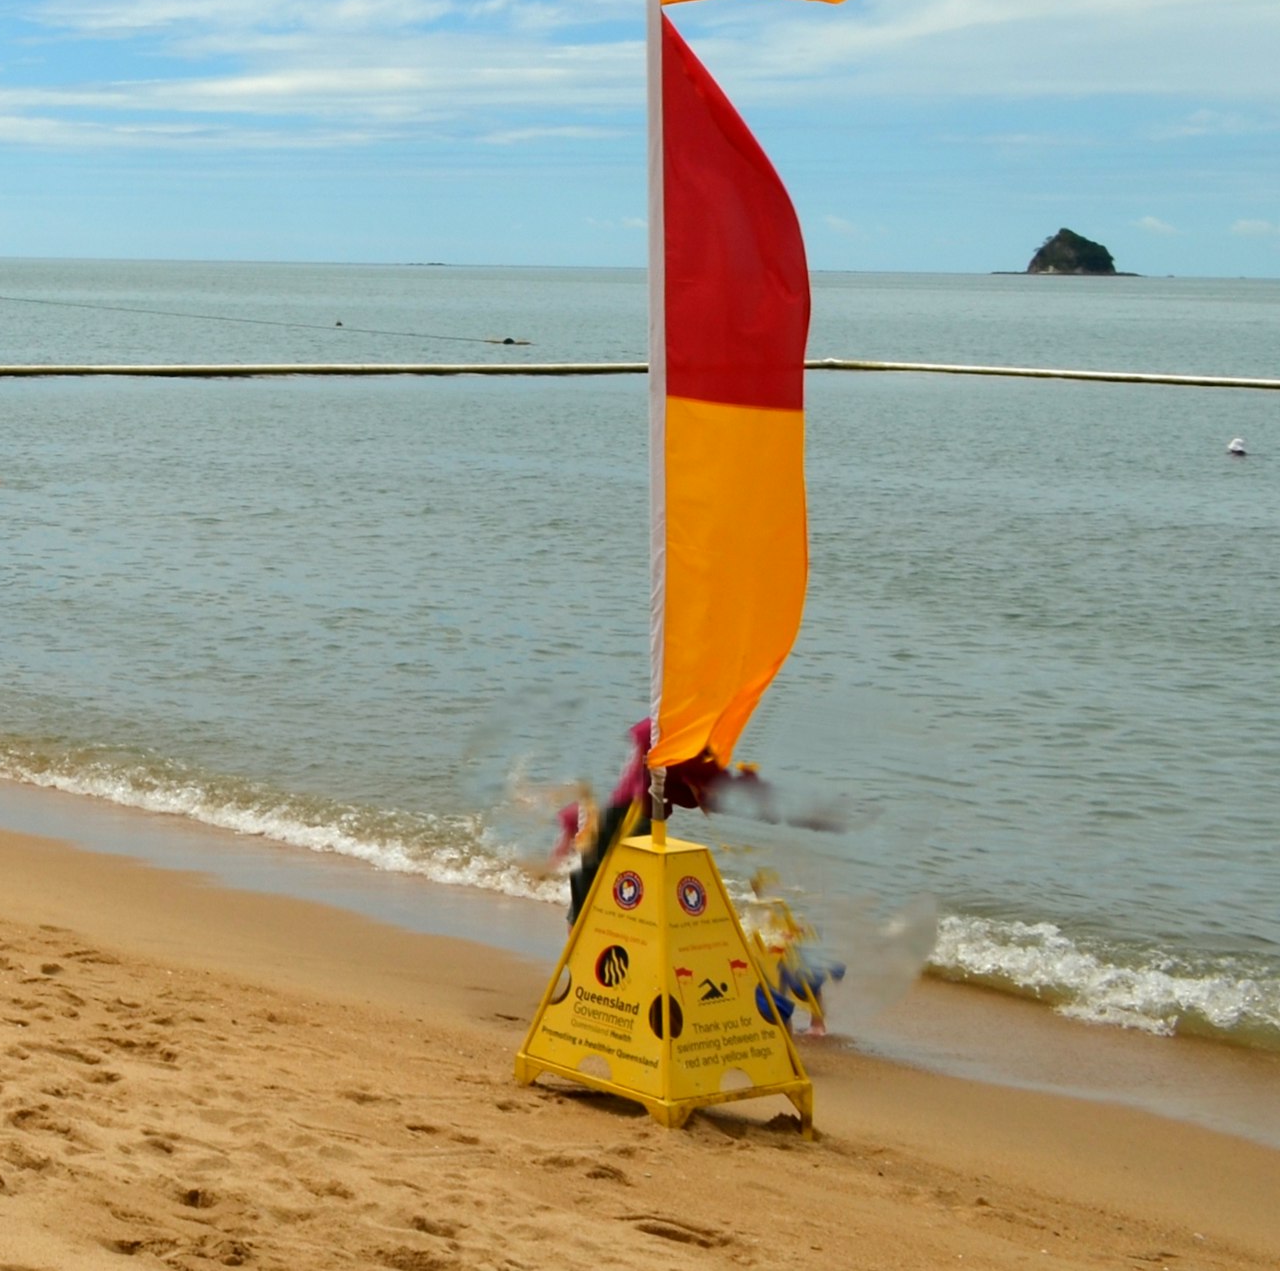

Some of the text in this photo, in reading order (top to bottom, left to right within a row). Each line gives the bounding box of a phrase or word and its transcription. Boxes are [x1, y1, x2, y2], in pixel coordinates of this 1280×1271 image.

[575, 986, 640, 1015] Queensland
[573, 1001, 634, 1030] Government
[692, 1016, 752, 1034] Thank you for
[541, 1026, 659, 1069] Promoting a healthier Queensland
[610, 1031, 632, 1043] Health
[677, 1029, 776, 1054] swimming between the
[685, 1057, 700, 1069] red
[702, 1053, 719, 1067] and
[721, 1050, 749, 1066] yellow
